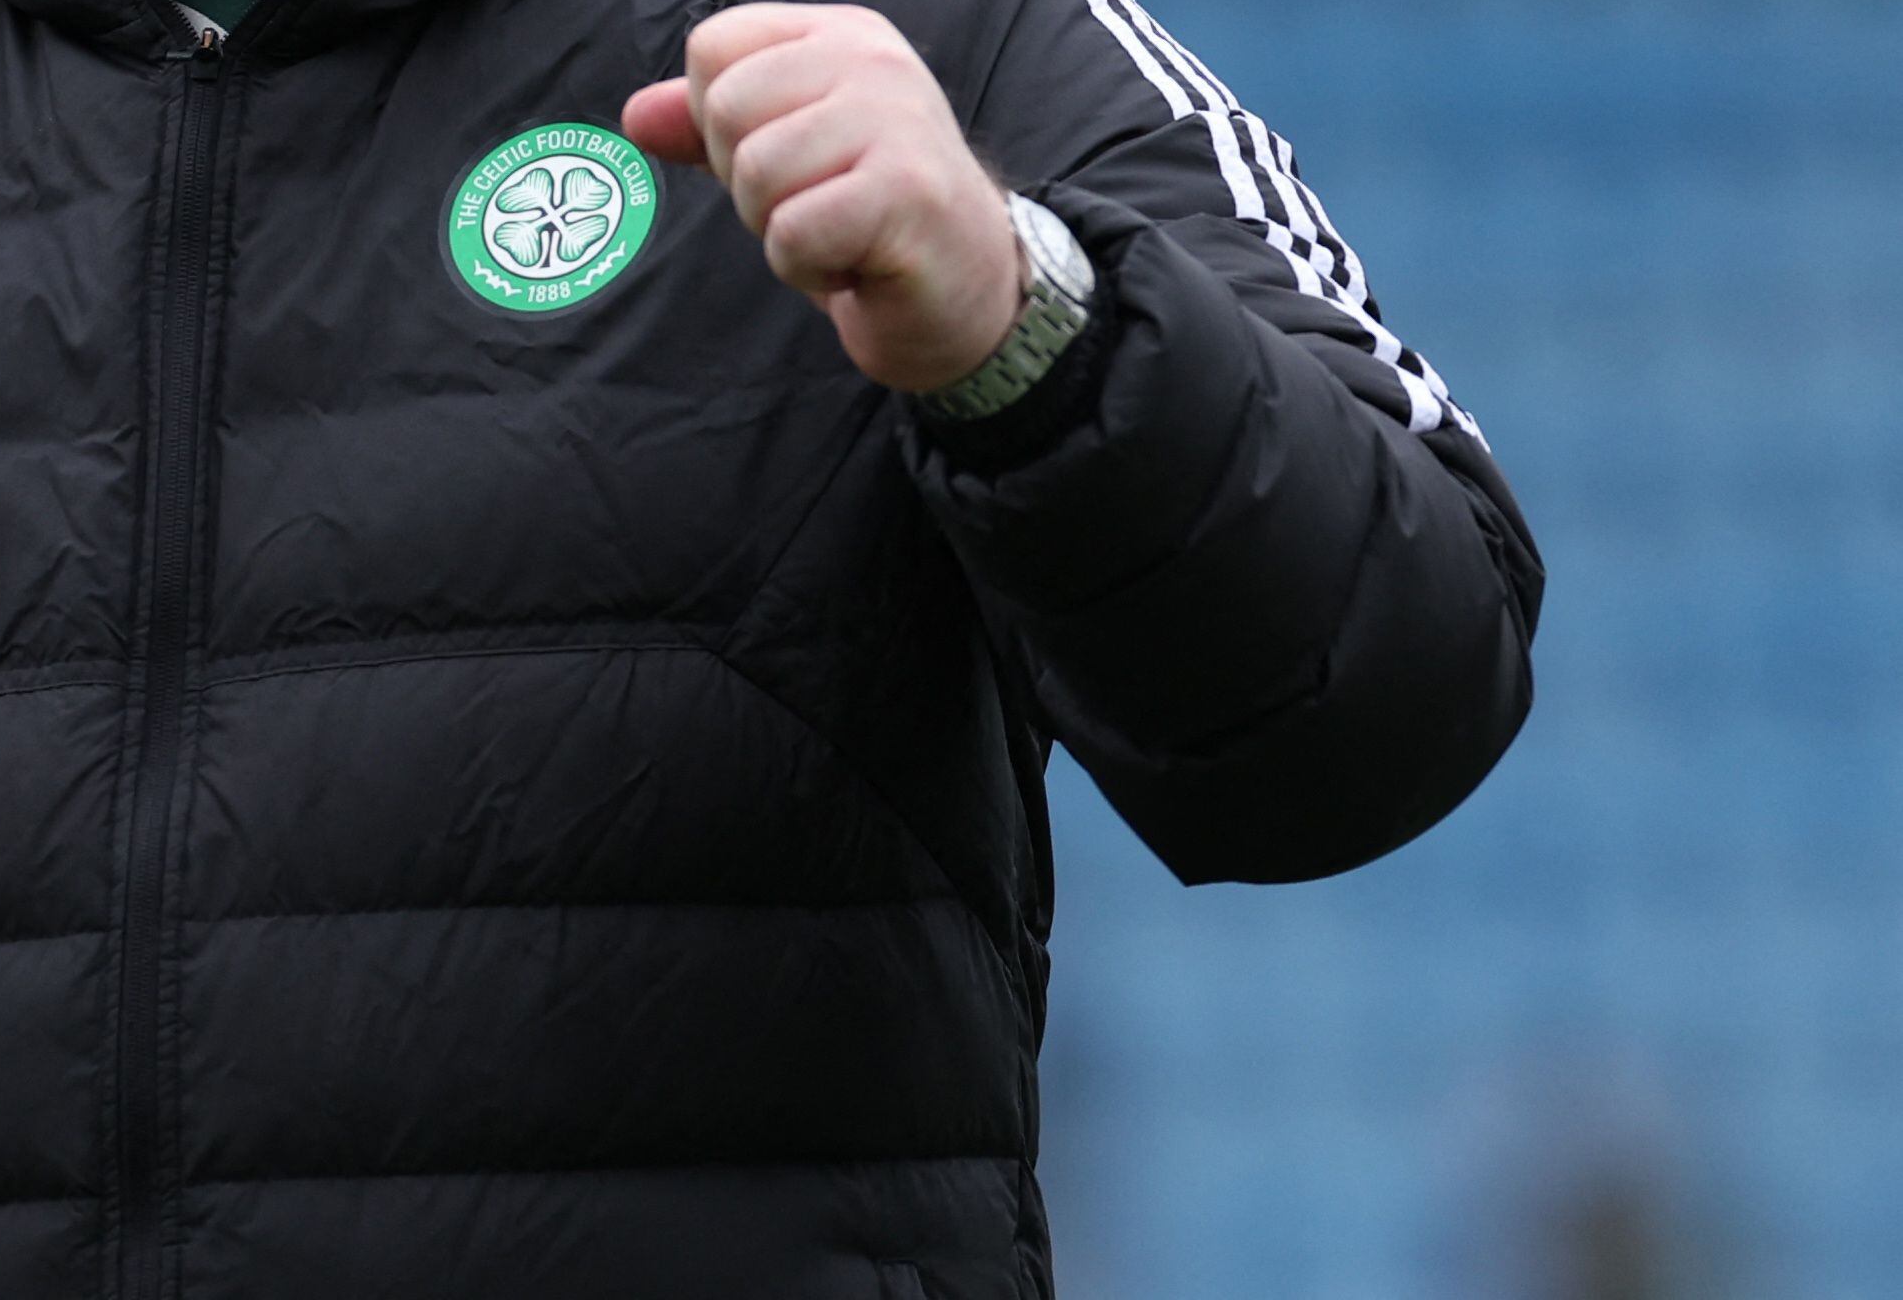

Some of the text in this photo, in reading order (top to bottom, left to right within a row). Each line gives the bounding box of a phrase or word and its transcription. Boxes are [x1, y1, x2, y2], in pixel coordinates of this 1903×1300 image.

[457, 129, 650, 230] THE CELTIC FOOTBALL CLUB
[527, 281, 571, 303] 1888
